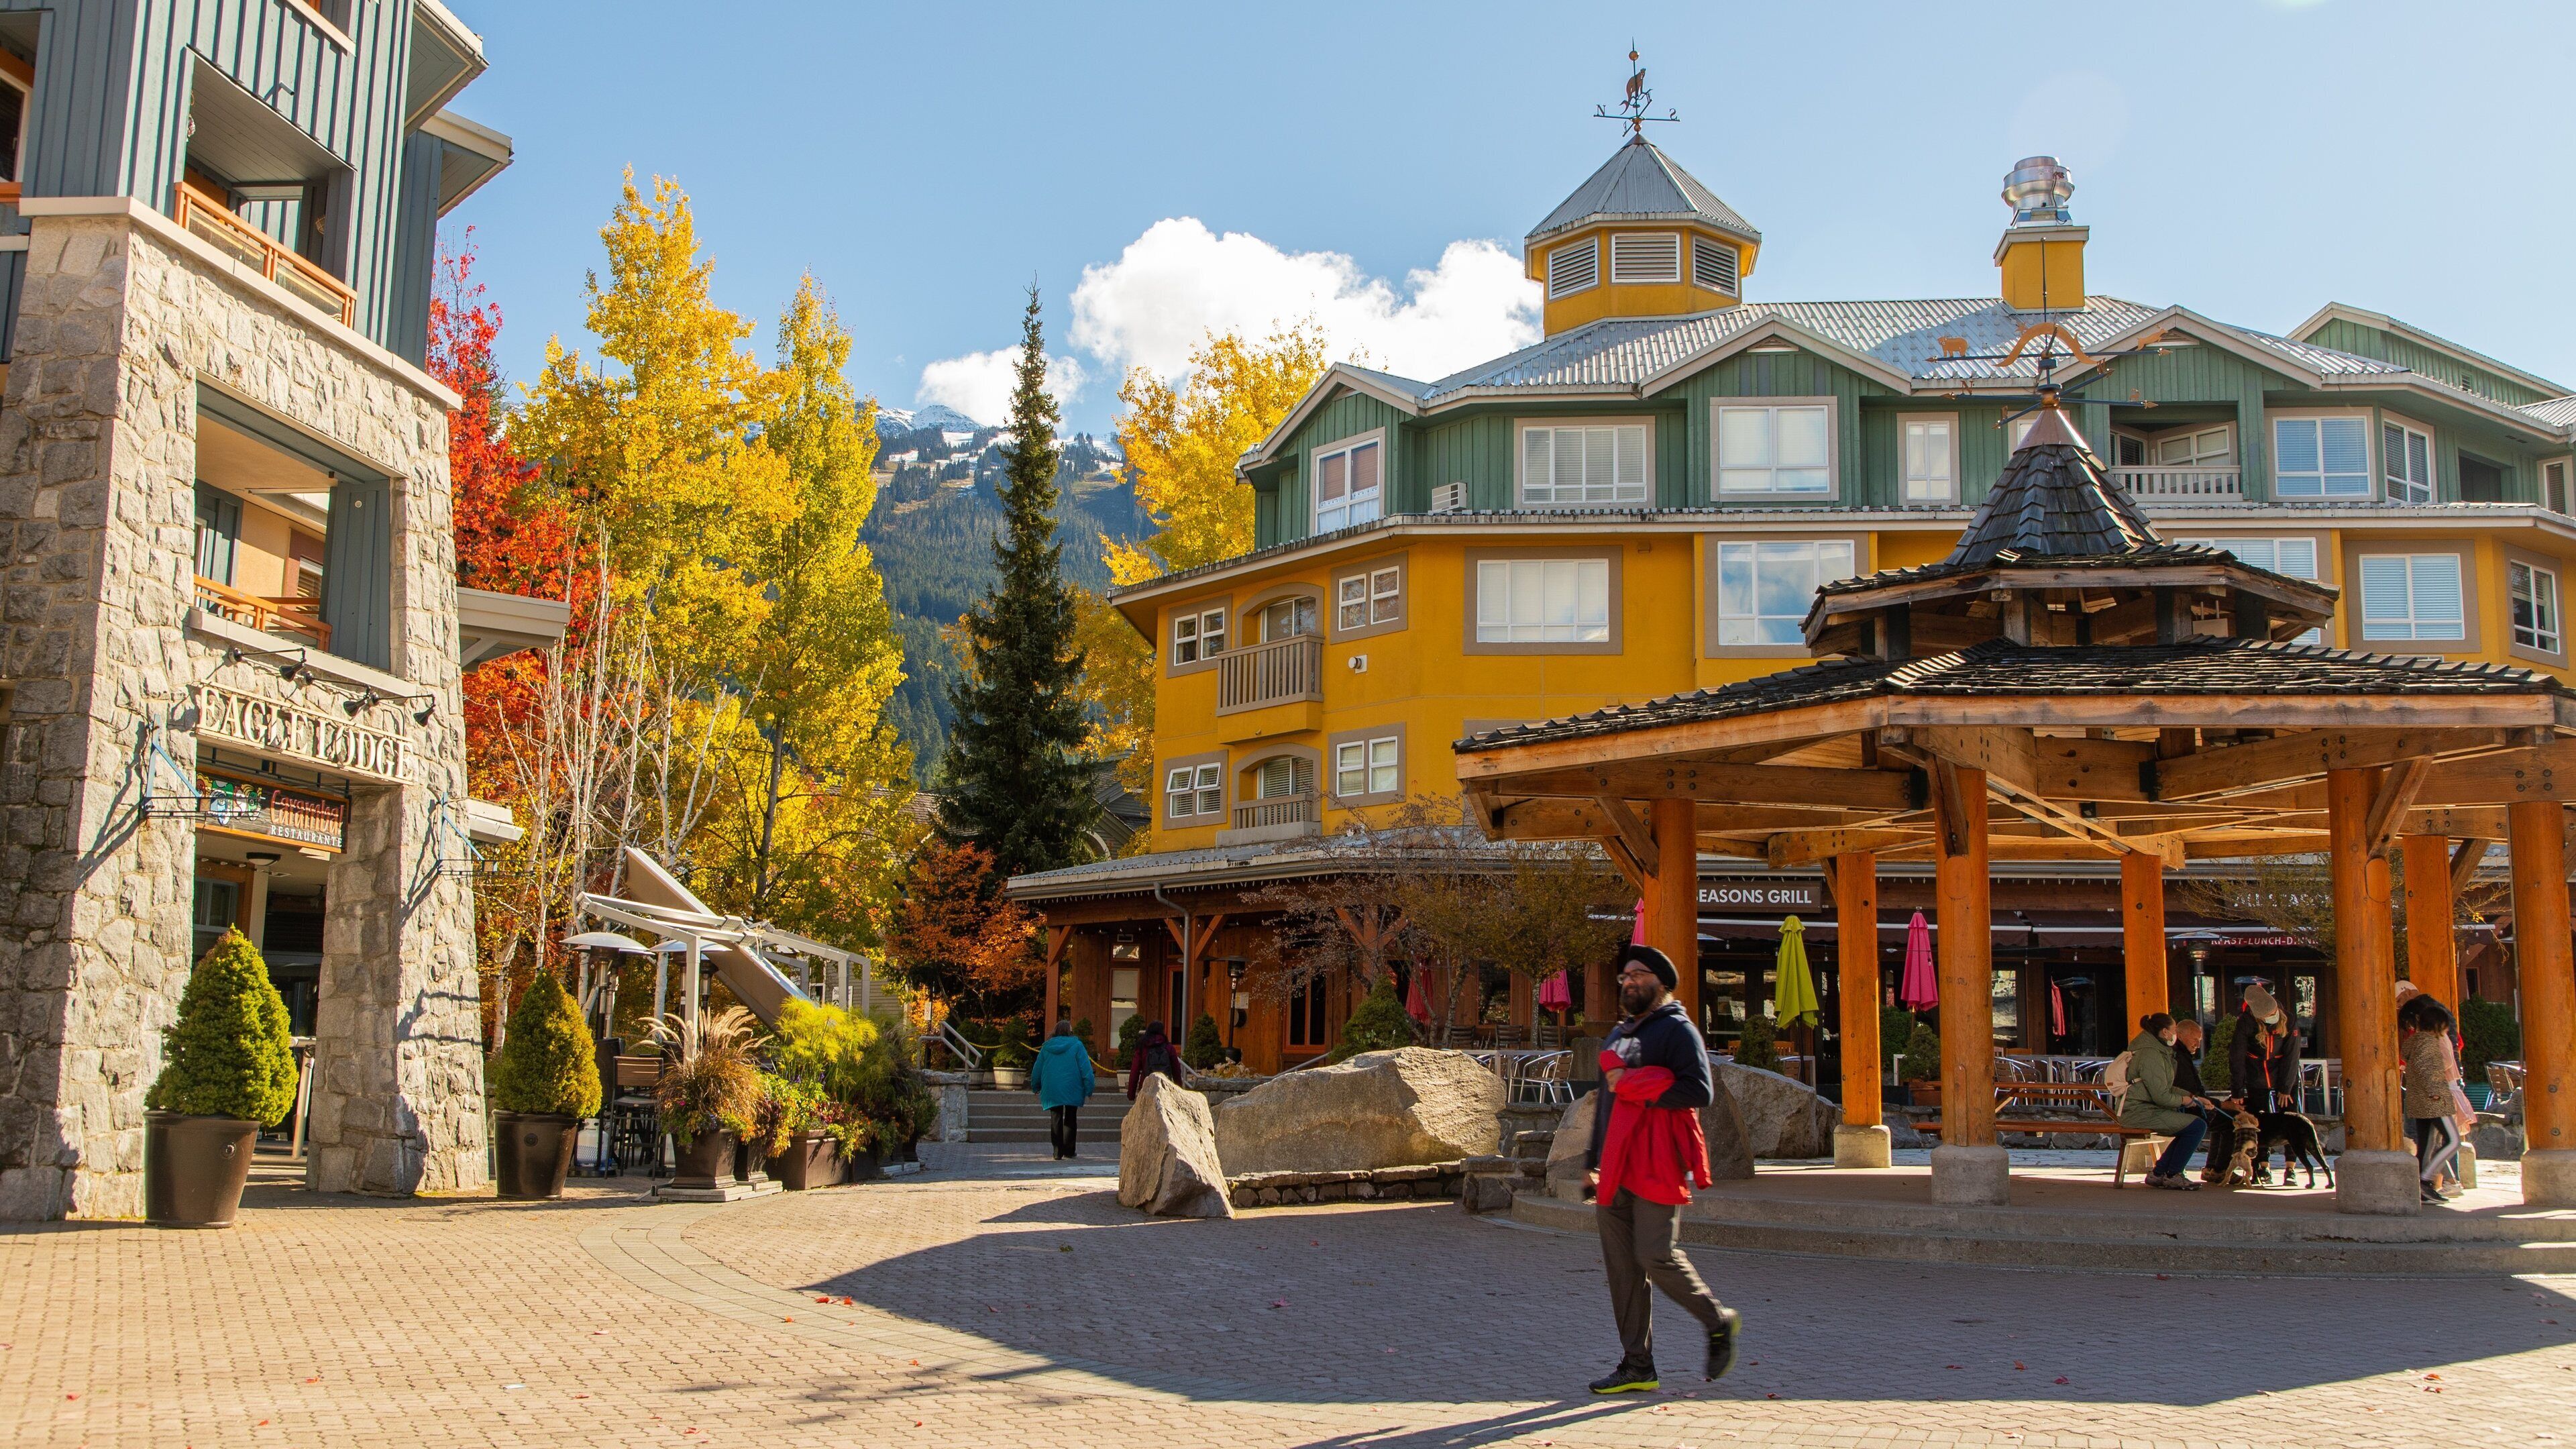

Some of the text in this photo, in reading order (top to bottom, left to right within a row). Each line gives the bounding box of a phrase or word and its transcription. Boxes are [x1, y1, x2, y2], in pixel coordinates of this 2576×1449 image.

[1596, 104, 1606, 117] N
[1960, 380, 1974, 395] N
[196, 686, 413, 781] EAGLE LODGE
[270, 790, 344, 837] Caramba!
[270, 824, 342, 847] RESTAURANTE
[1697, 889, 1812, 904] EASONS GRILL
